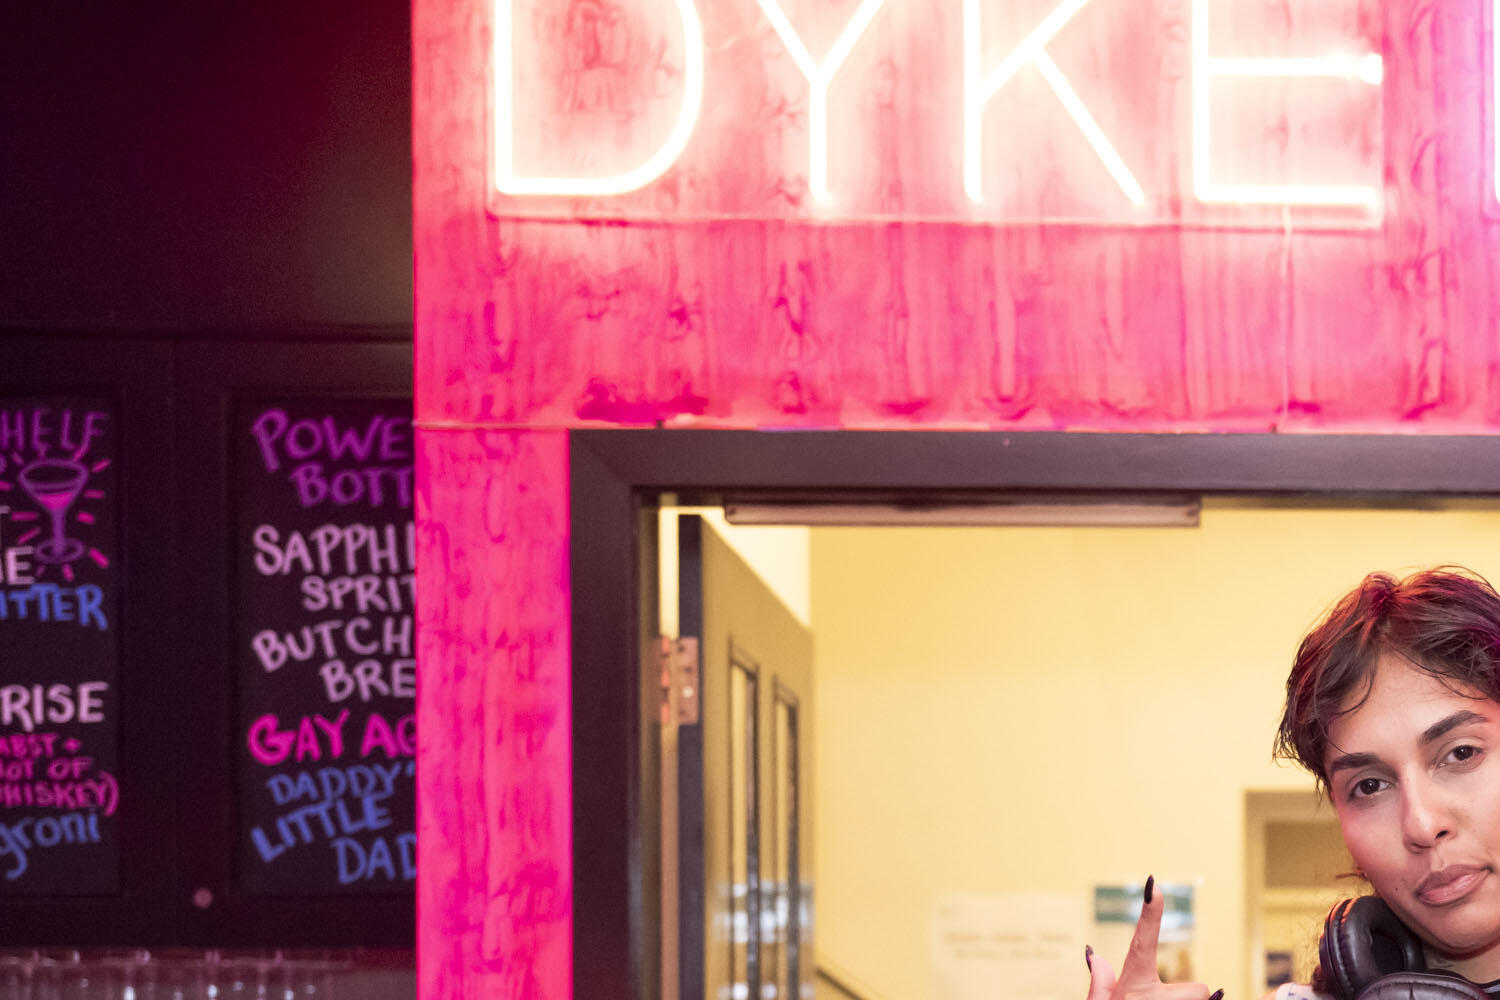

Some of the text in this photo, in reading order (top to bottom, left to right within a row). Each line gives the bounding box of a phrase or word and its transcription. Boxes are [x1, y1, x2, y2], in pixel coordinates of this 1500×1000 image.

[493, 0, 1384, 206] DYKE
[252, 616, 412, 672] BUTCH
[248, 709, 350, 766] GAY
[47, 756, 94, 781] OF
[252, 796, 393, 862] LITTLE
